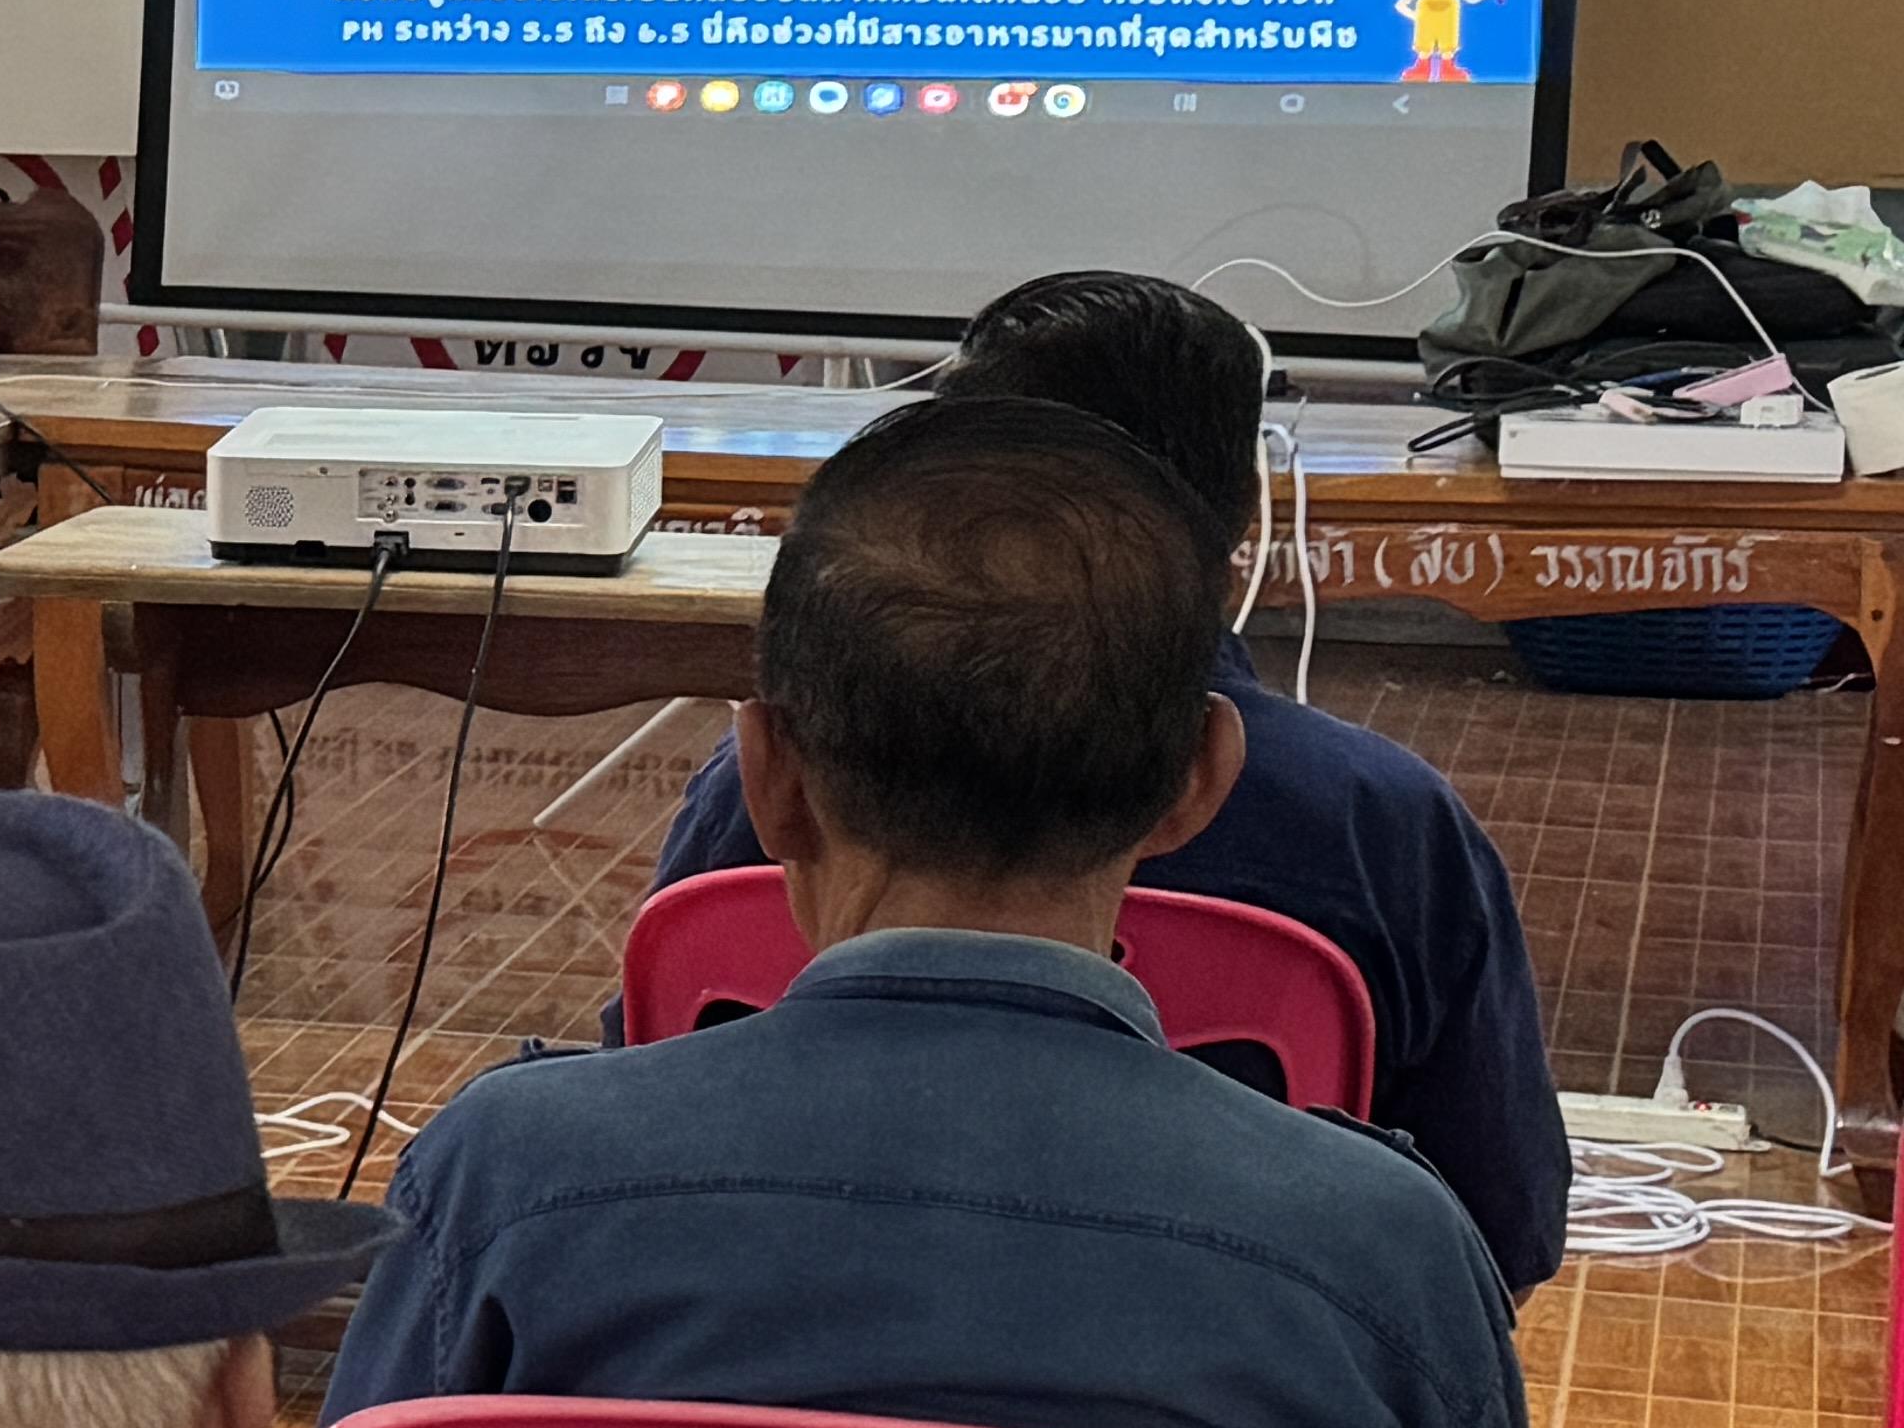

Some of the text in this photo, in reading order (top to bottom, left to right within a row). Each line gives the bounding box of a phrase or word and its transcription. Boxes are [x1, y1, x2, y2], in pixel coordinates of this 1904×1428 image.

[342, 19, 384, 42] PH
[395, 13, 511, 44] ระหว่าง
[522, 19, 574, 44] 5.5
[585, 16, 626, 43] ถึง
[637, 20, 690, 44] 6.5
